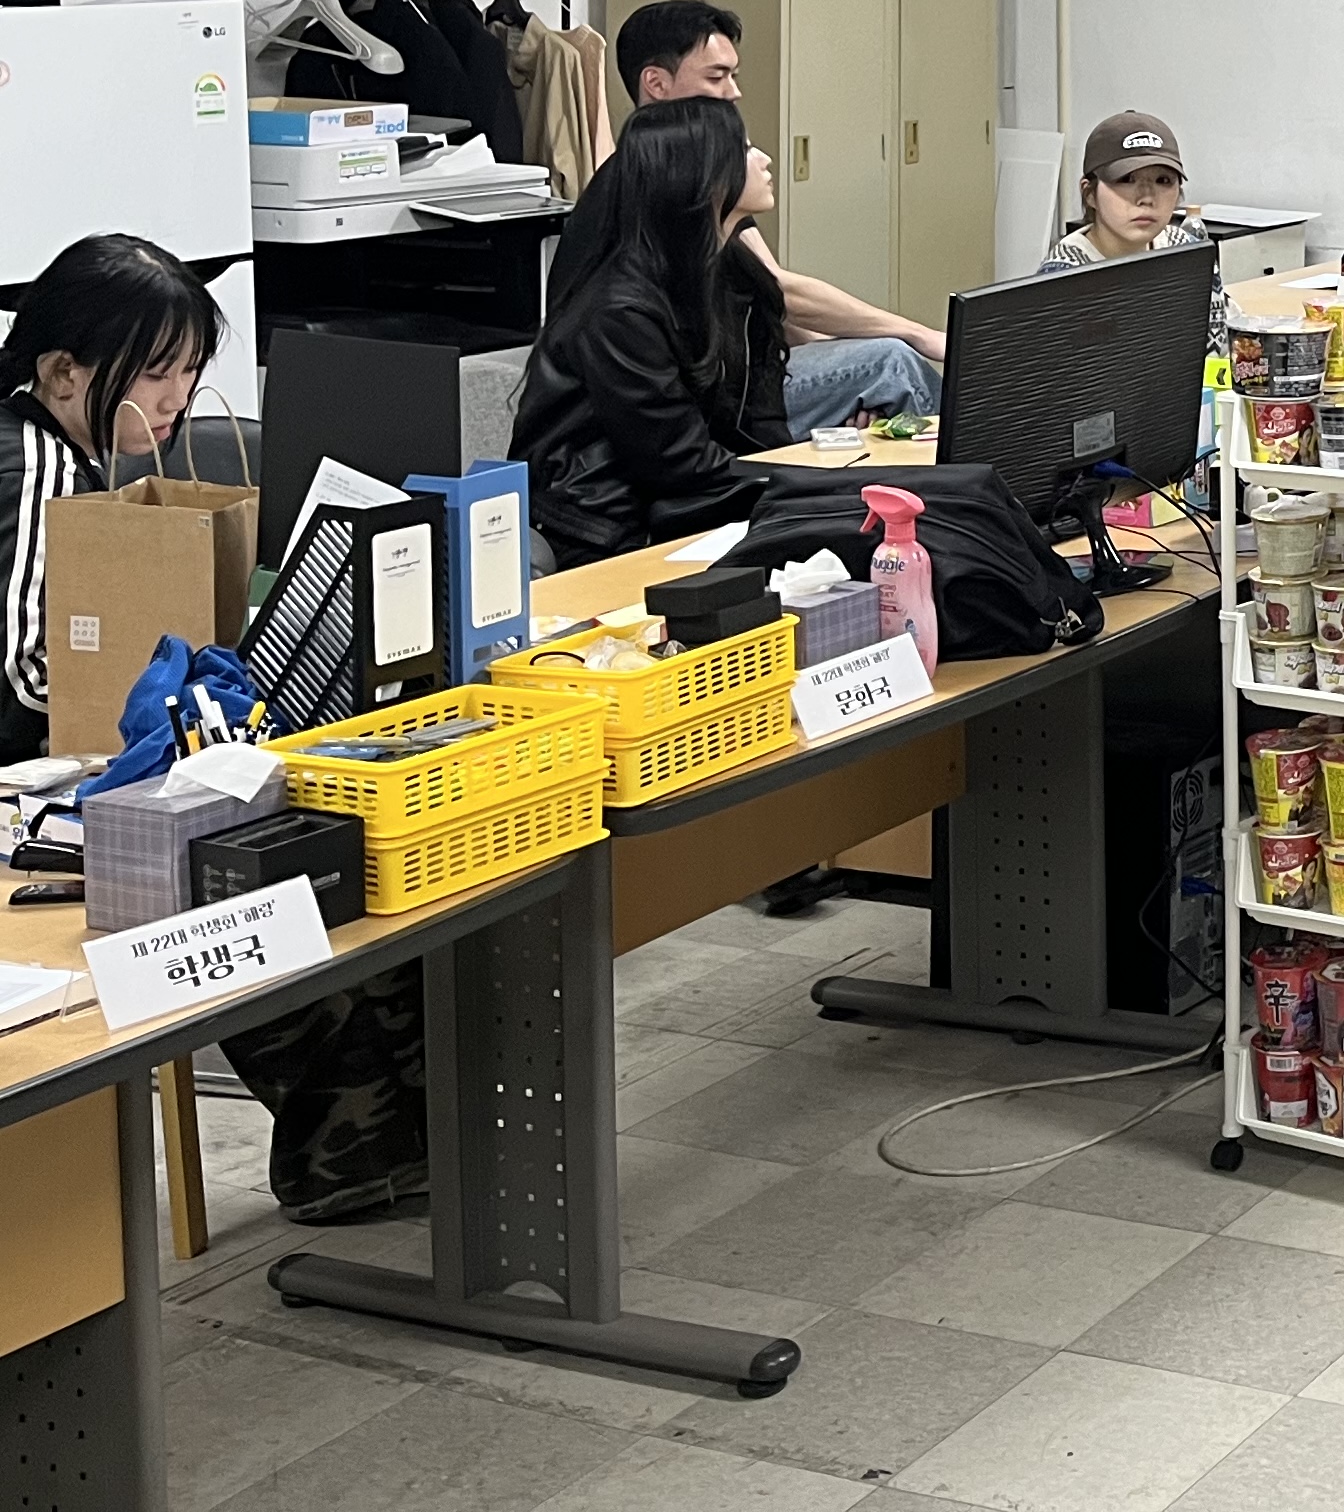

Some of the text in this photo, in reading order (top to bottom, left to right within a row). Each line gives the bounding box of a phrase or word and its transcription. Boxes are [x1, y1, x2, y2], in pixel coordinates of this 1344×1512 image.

[214, 27, 226, 36] LG
[872, 554, 905, 574] nuggle
[387, 645, 421, 659] SYSMAX
[834, 675, 892, 717] 문화국
[191, 916, 238, 938] 학생회
[164, 934, 266, 987] 학생국
[1263, 978, 1298, 1026] 辛
